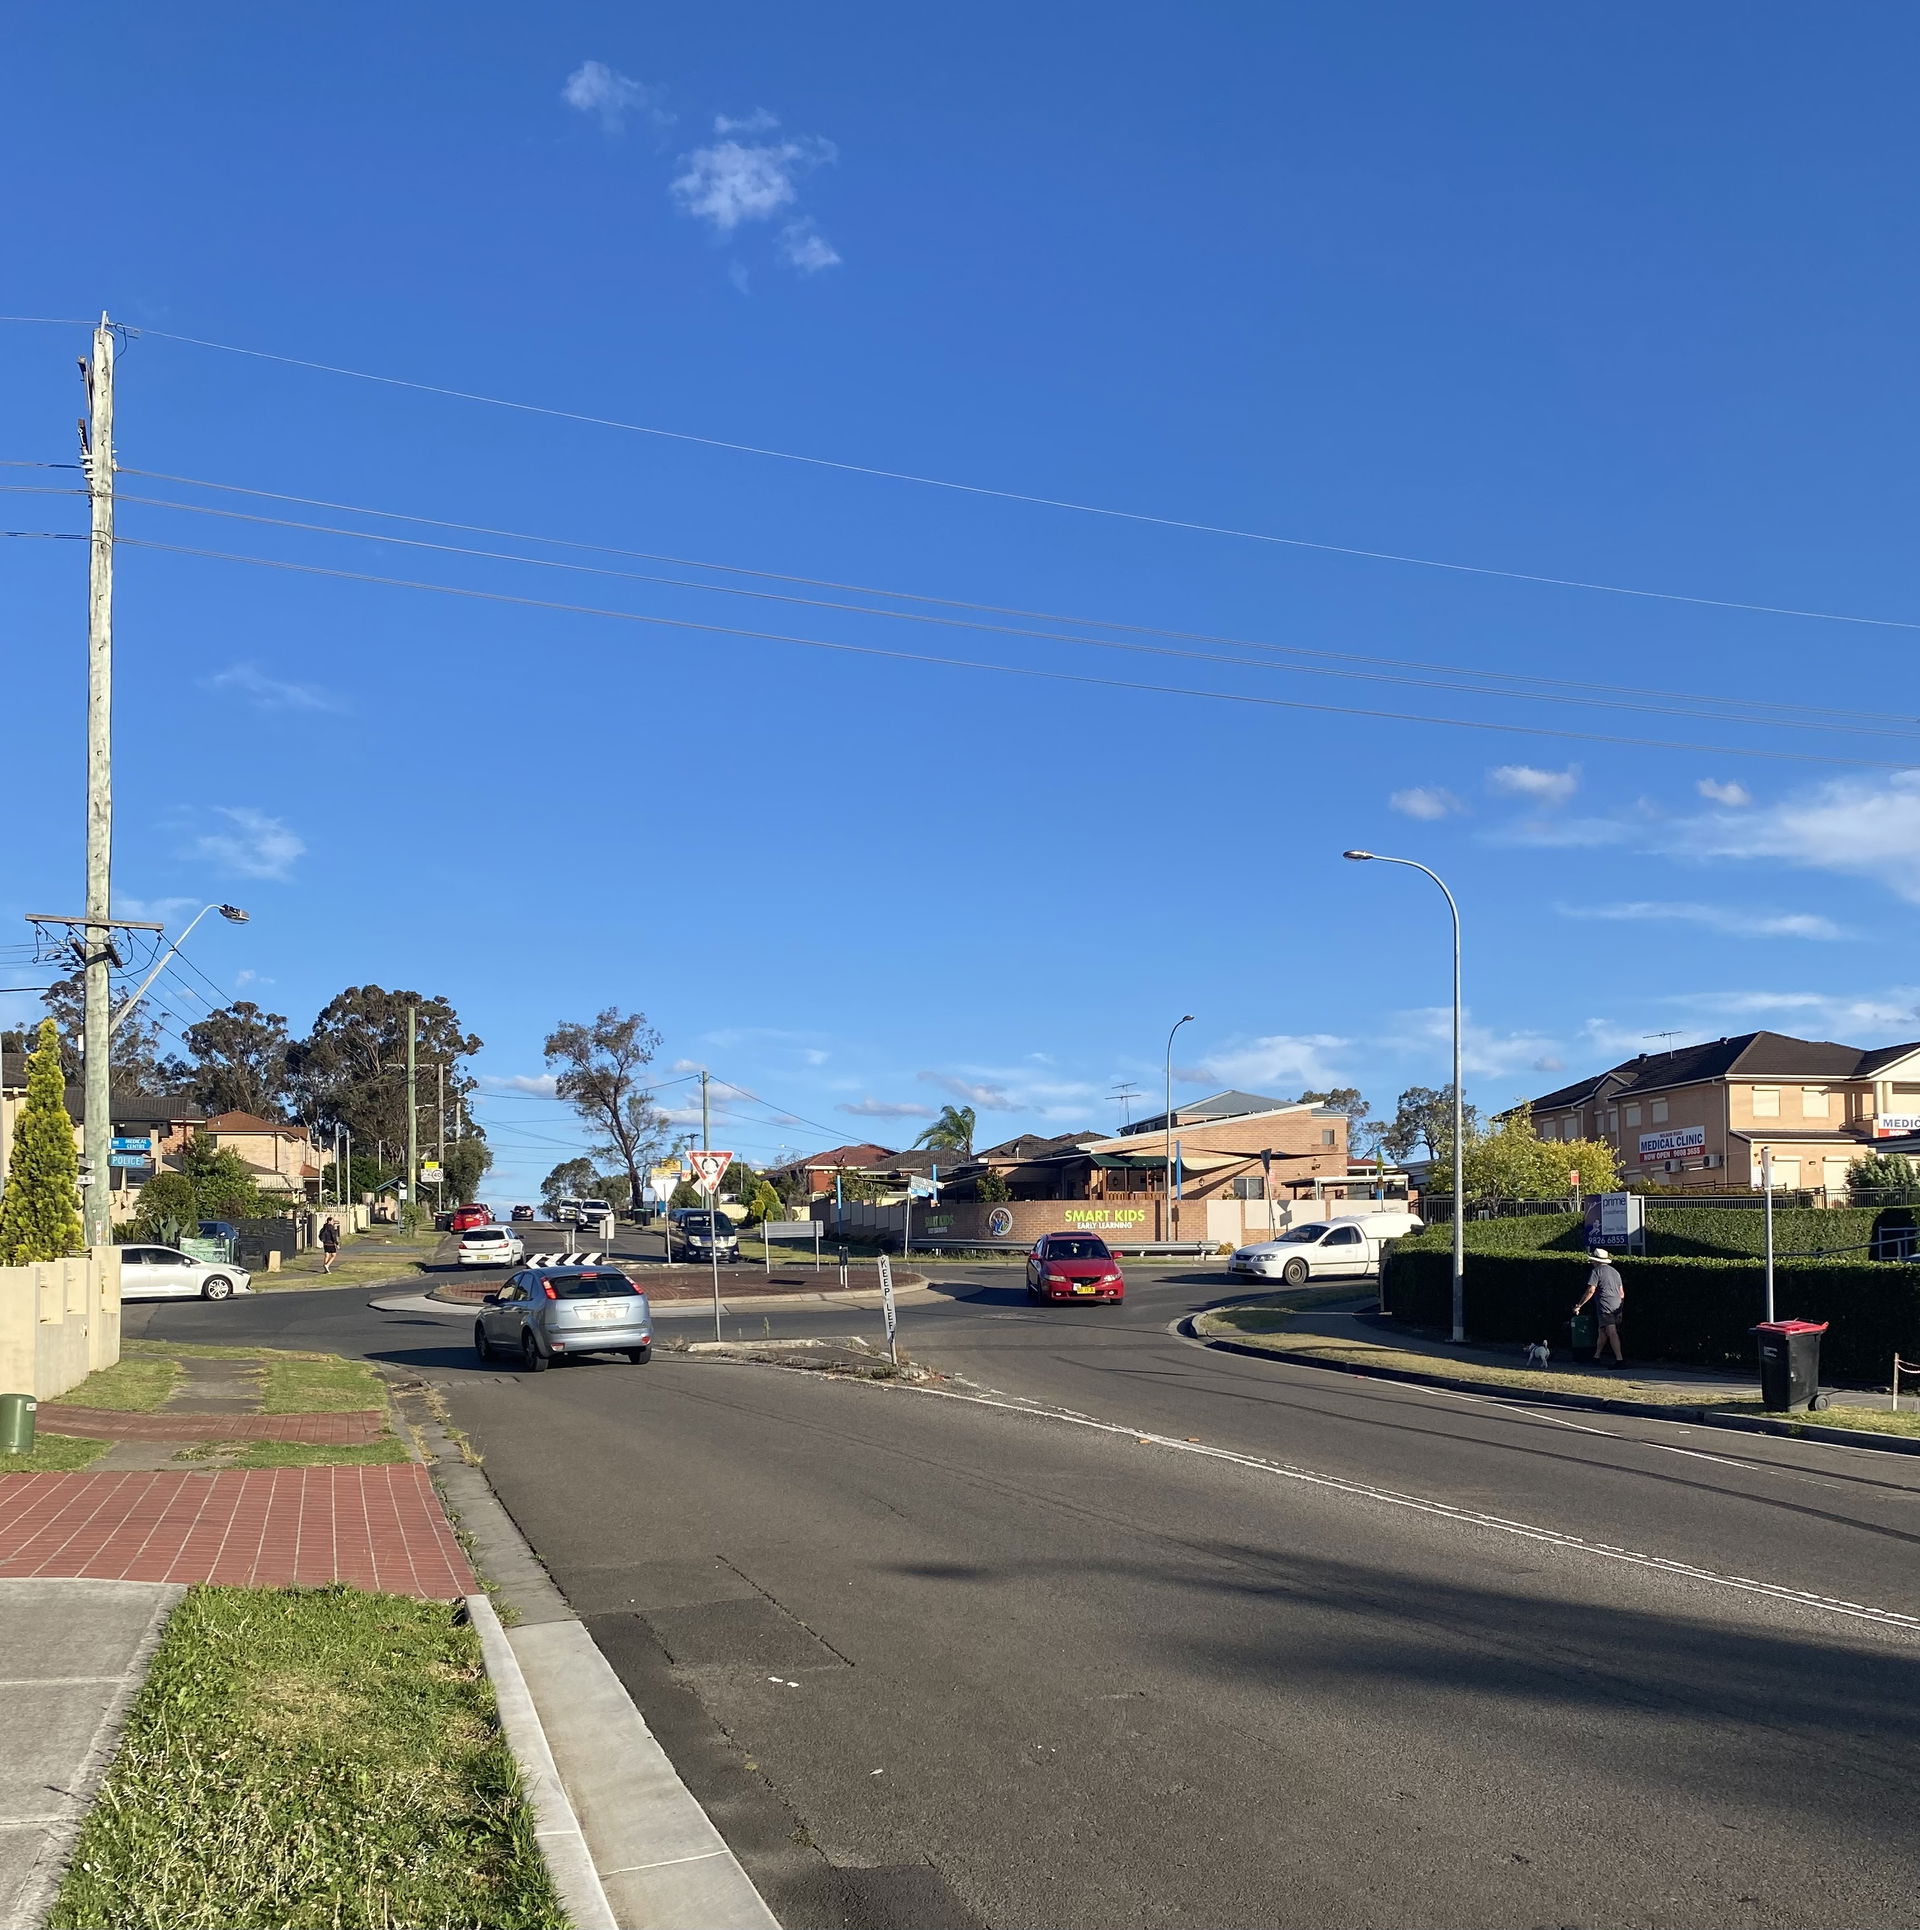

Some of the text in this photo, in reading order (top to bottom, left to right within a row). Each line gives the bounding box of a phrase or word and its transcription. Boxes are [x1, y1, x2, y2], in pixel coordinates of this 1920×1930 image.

[1641, 1133, 1703, 1151] MEDICAL CLINIC
[112, 1155, 141, 1166] POLICE
[1656, 1151, 1671, 1159] OPEN
[1603, 1197, 1626, 1208] prime
[1064, 1209, 1145, 1222] SMART KIDS
[1077, 1221, 1133, 1230] EARLY LEARNING
[1588, 1235, 1625, 1245] 9826 6855
[880, 1259, 891, 1296] KEEP
